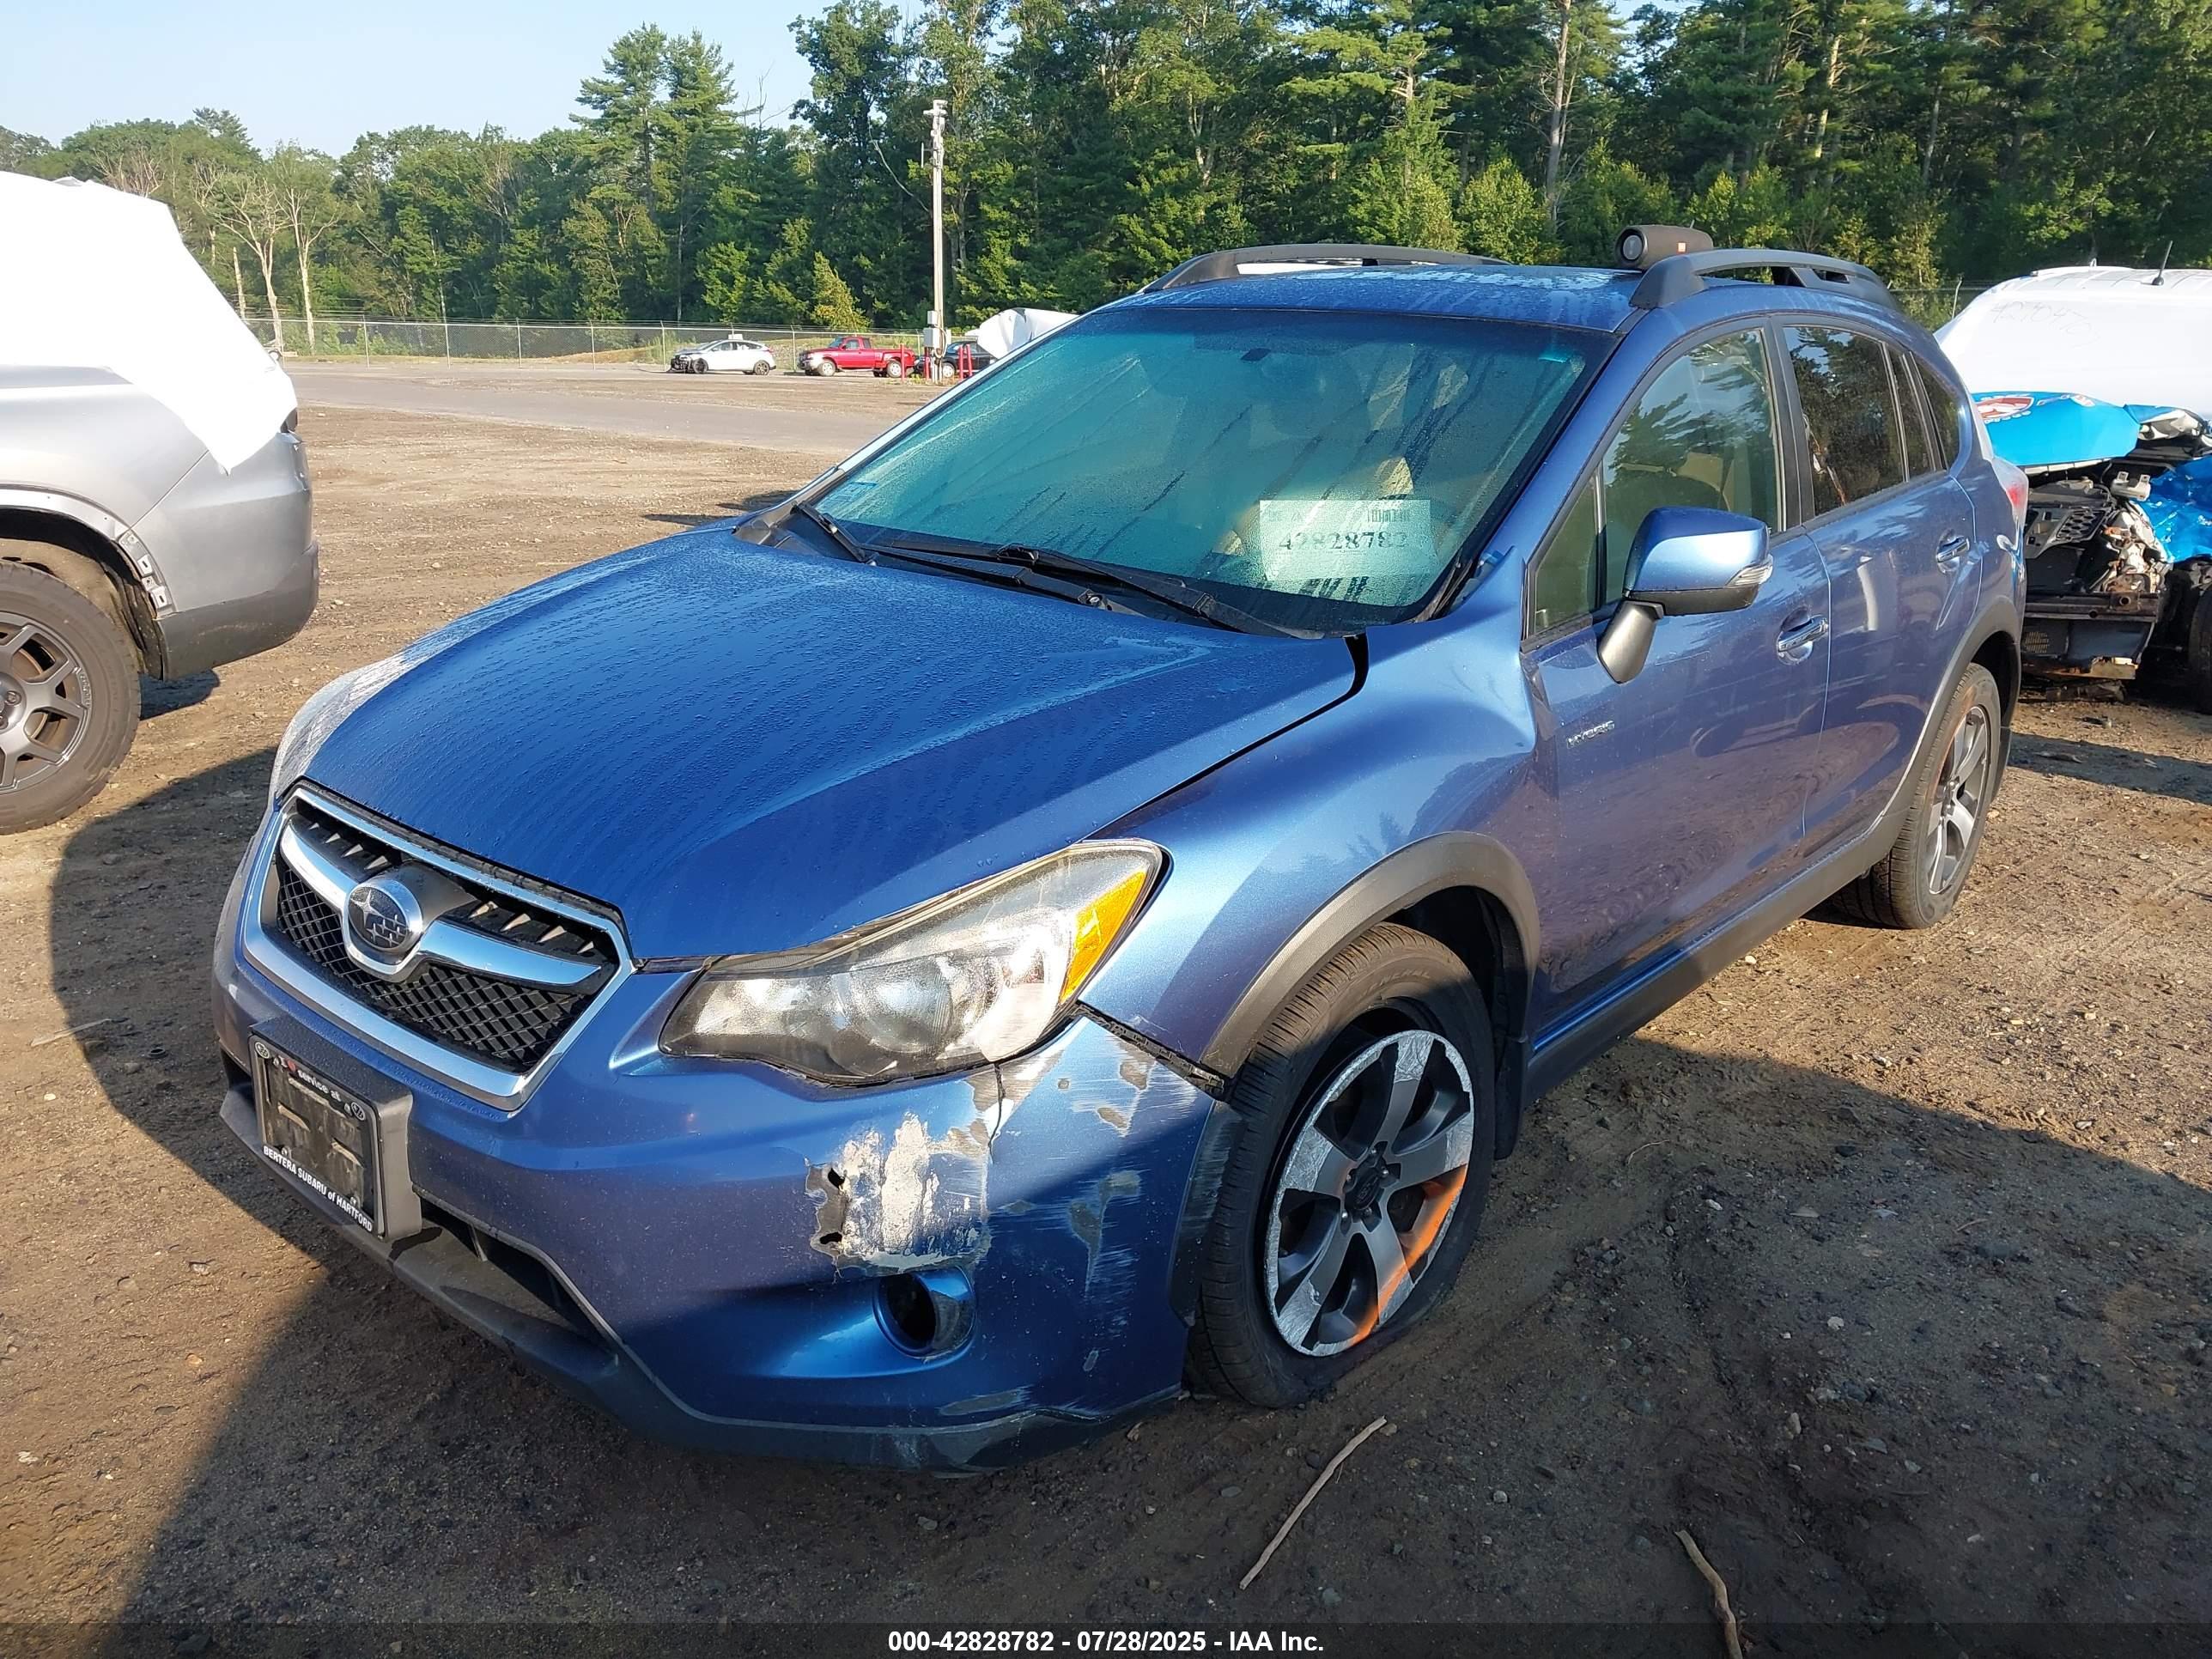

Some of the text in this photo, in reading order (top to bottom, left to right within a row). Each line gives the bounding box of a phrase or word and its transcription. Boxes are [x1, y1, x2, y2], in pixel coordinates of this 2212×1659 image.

[1279, 531, 1411, 550] 42828782
[263, 1145, 373, 1232] BERTERA SUBARU of HARTFORD
